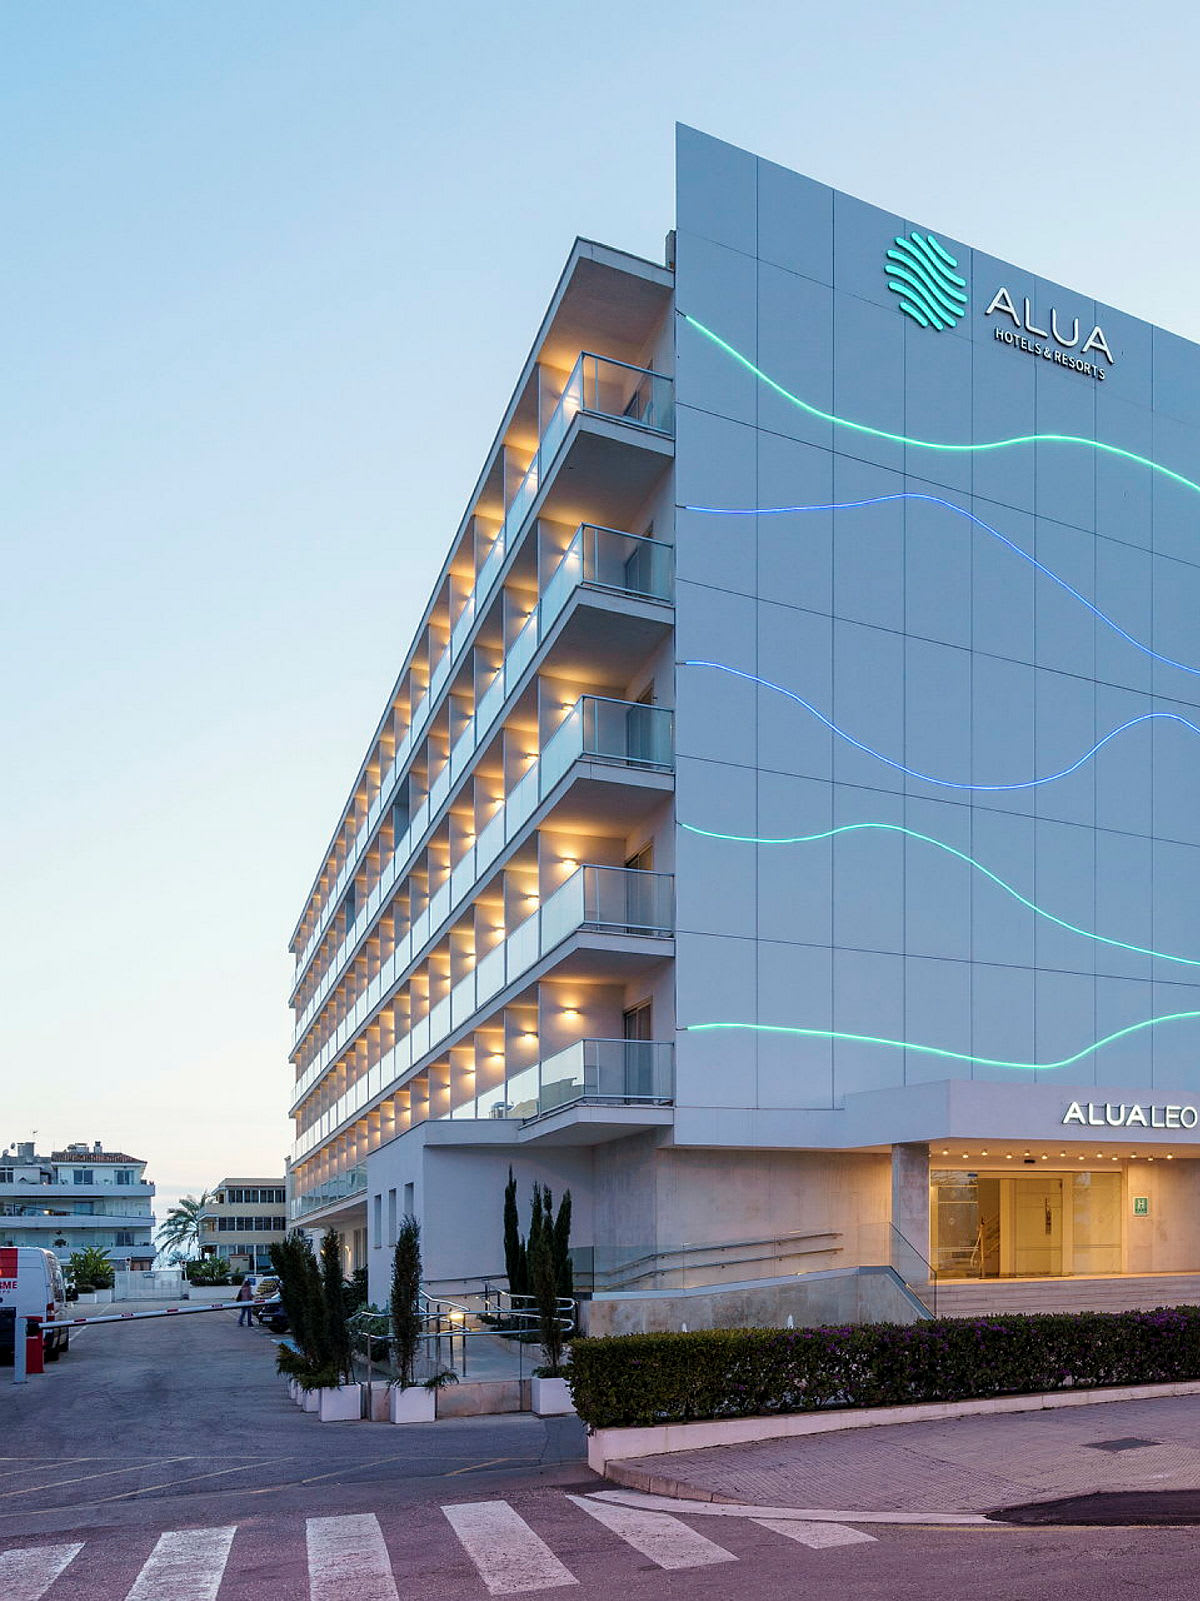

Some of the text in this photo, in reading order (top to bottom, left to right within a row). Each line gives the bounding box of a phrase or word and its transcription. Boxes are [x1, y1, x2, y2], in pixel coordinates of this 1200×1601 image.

[985, 287, 1114, 364] ALUA
[995, 327, 1042, 356] HOTELS
[1054, 350, 1106, 380] RESORTS
